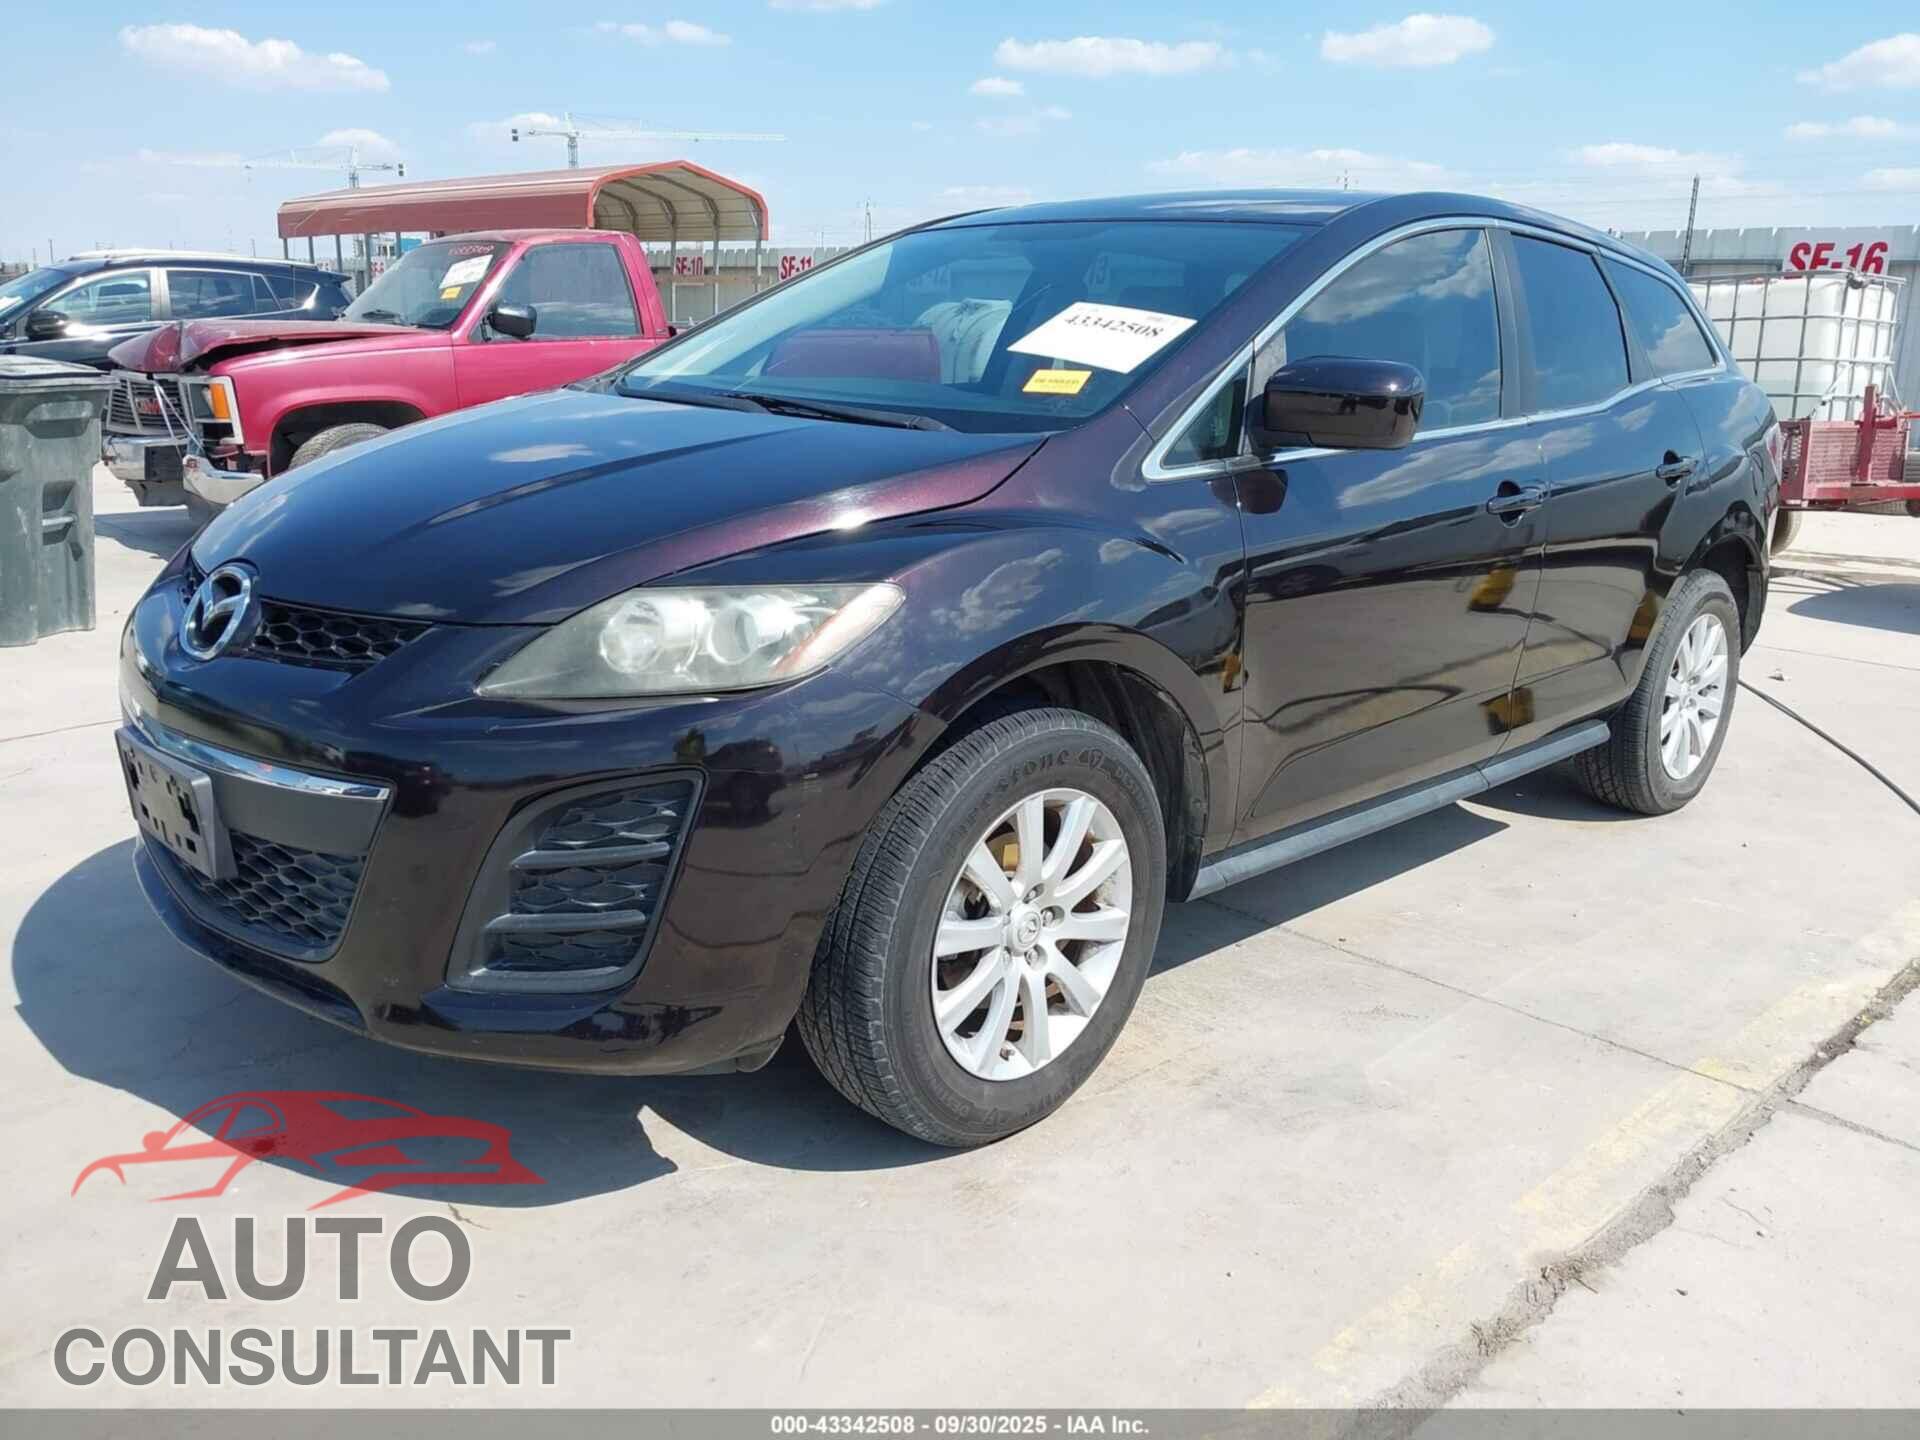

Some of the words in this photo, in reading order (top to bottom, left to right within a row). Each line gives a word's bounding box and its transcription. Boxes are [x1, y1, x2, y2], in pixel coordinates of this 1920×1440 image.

[675, 256, 704, 276] SF-10
[1789, 241, 1889, 274] SF-16
[1065, 314, 1165, 337] 43342508
